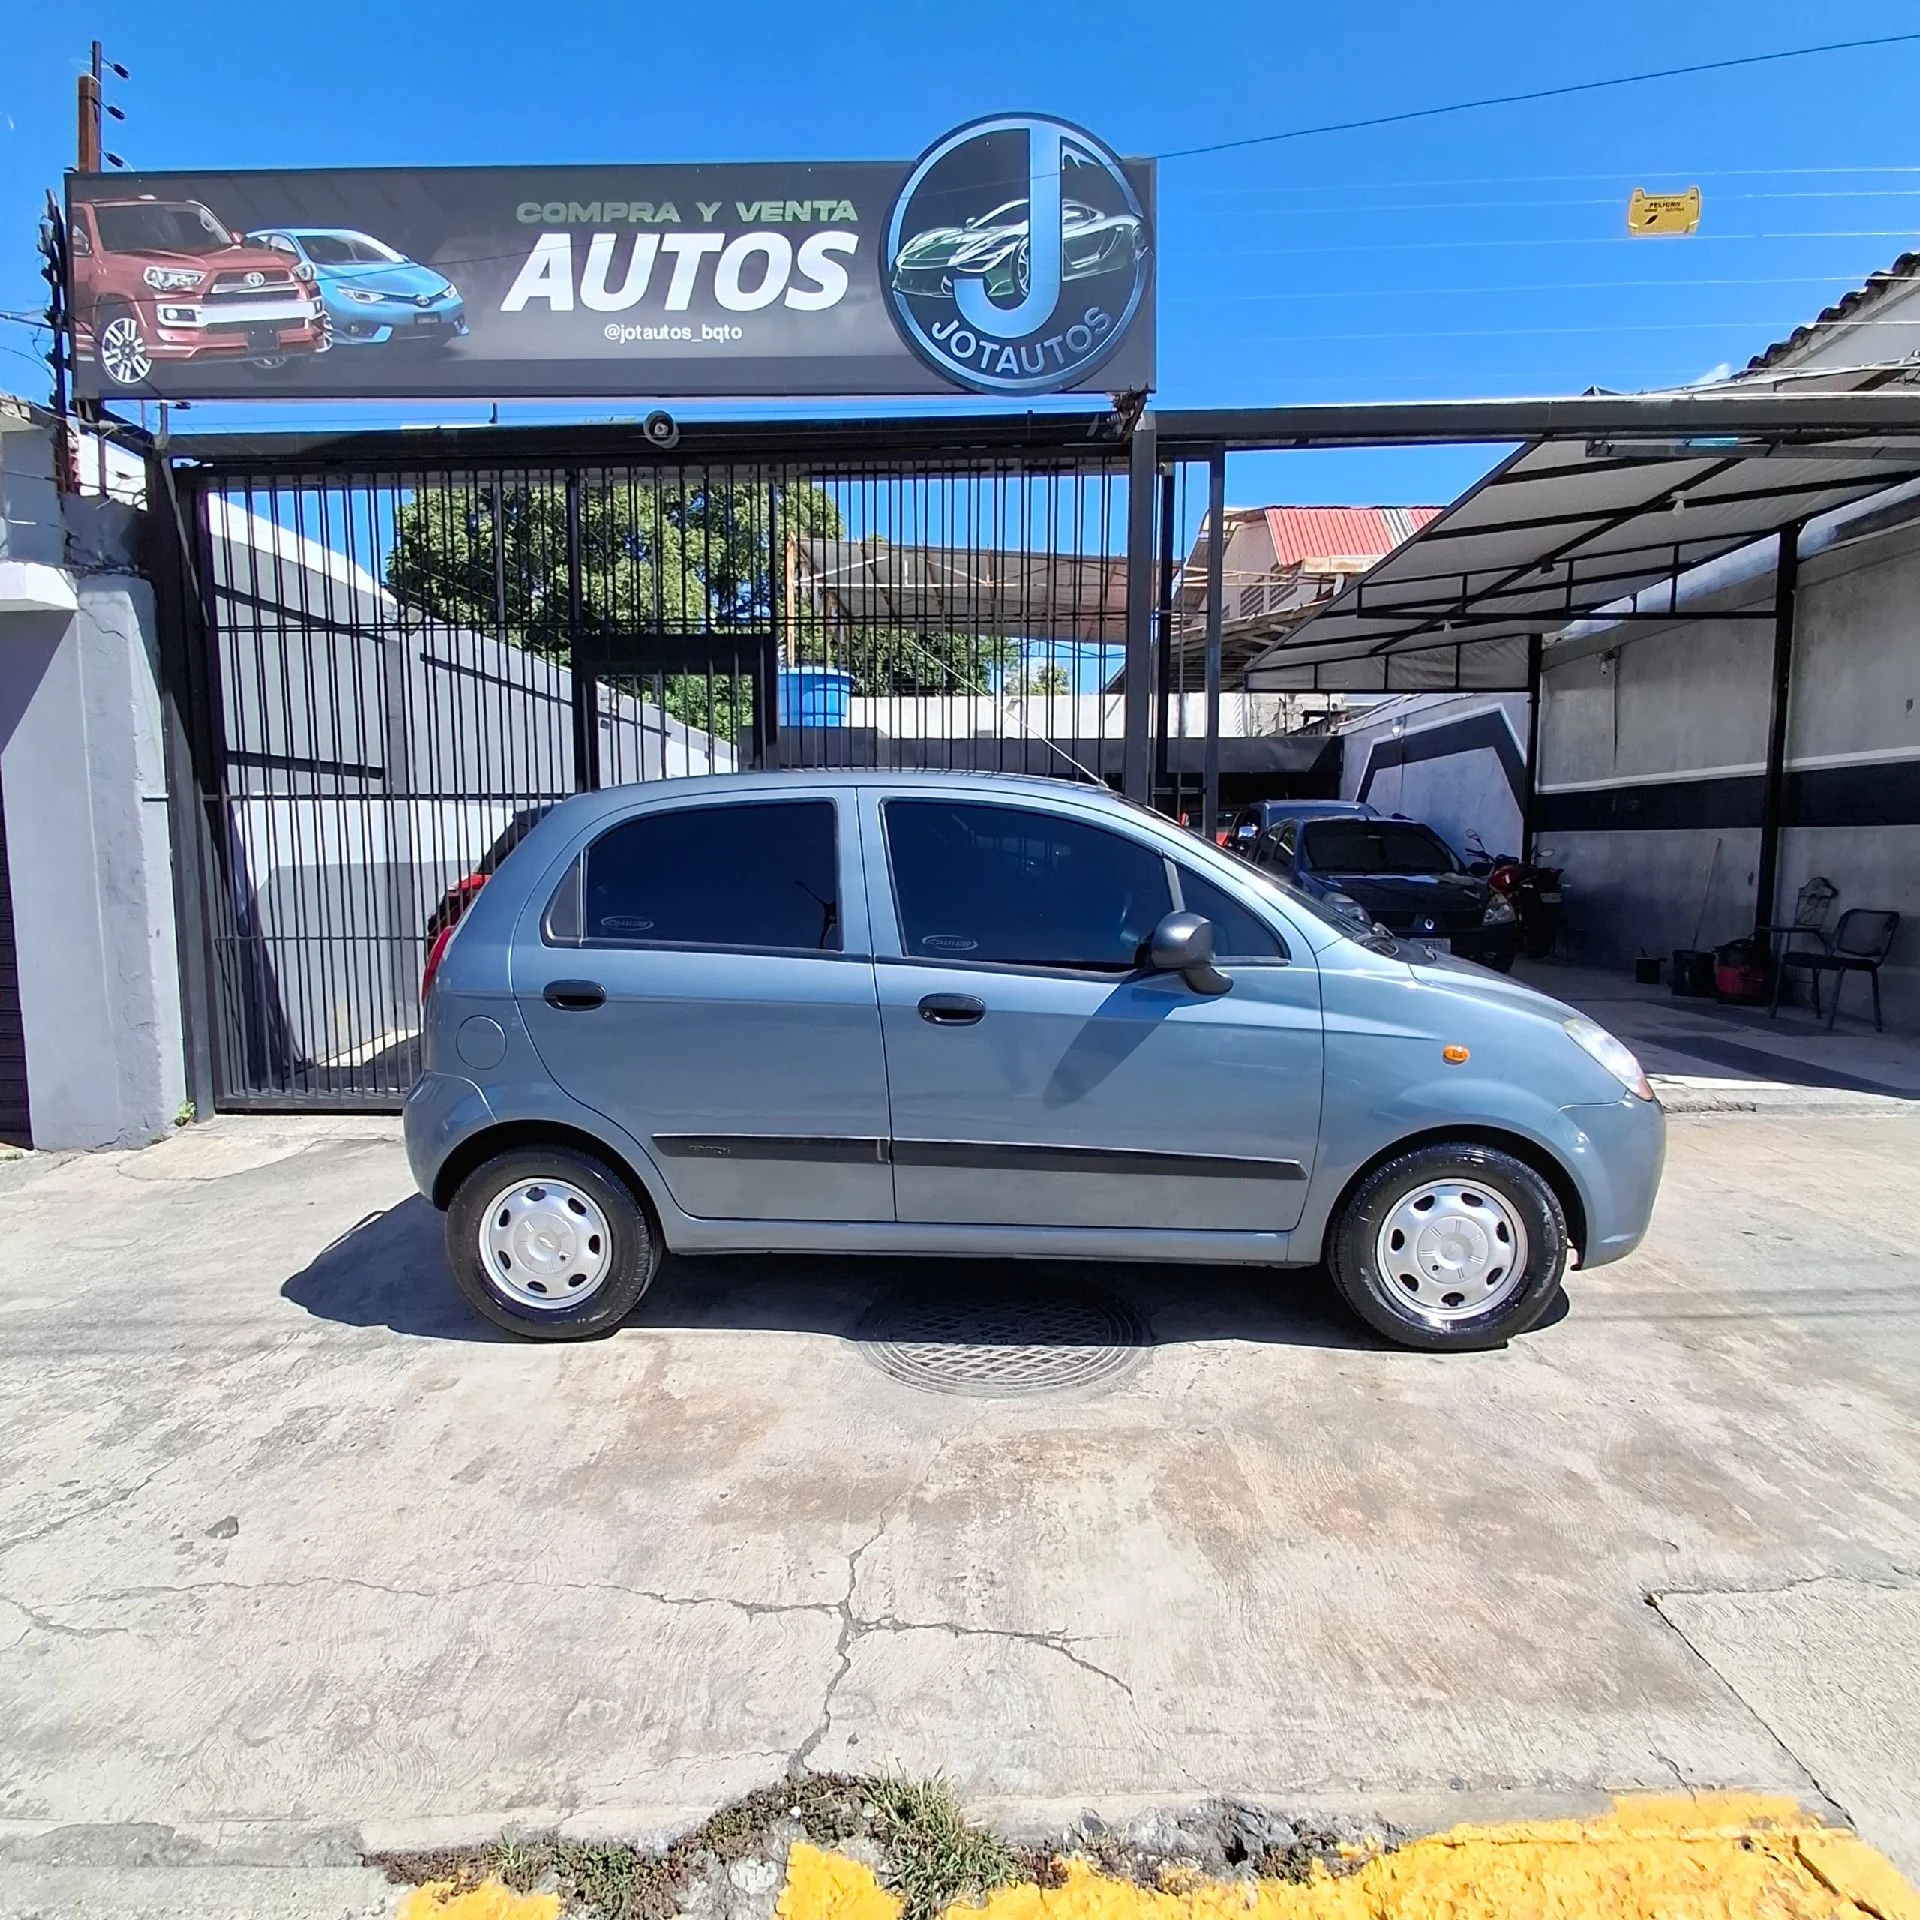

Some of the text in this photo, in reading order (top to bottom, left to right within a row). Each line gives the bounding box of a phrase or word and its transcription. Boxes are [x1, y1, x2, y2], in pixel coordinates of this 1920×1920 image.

[515, 200, 859, 223] COMPRA Y VENTA
[500, 231, 860, 312] AUTOS
[603, 324, 743, 344] @jotautos_bqto
[931, 306, 1112, 375] JOTAUTOS
